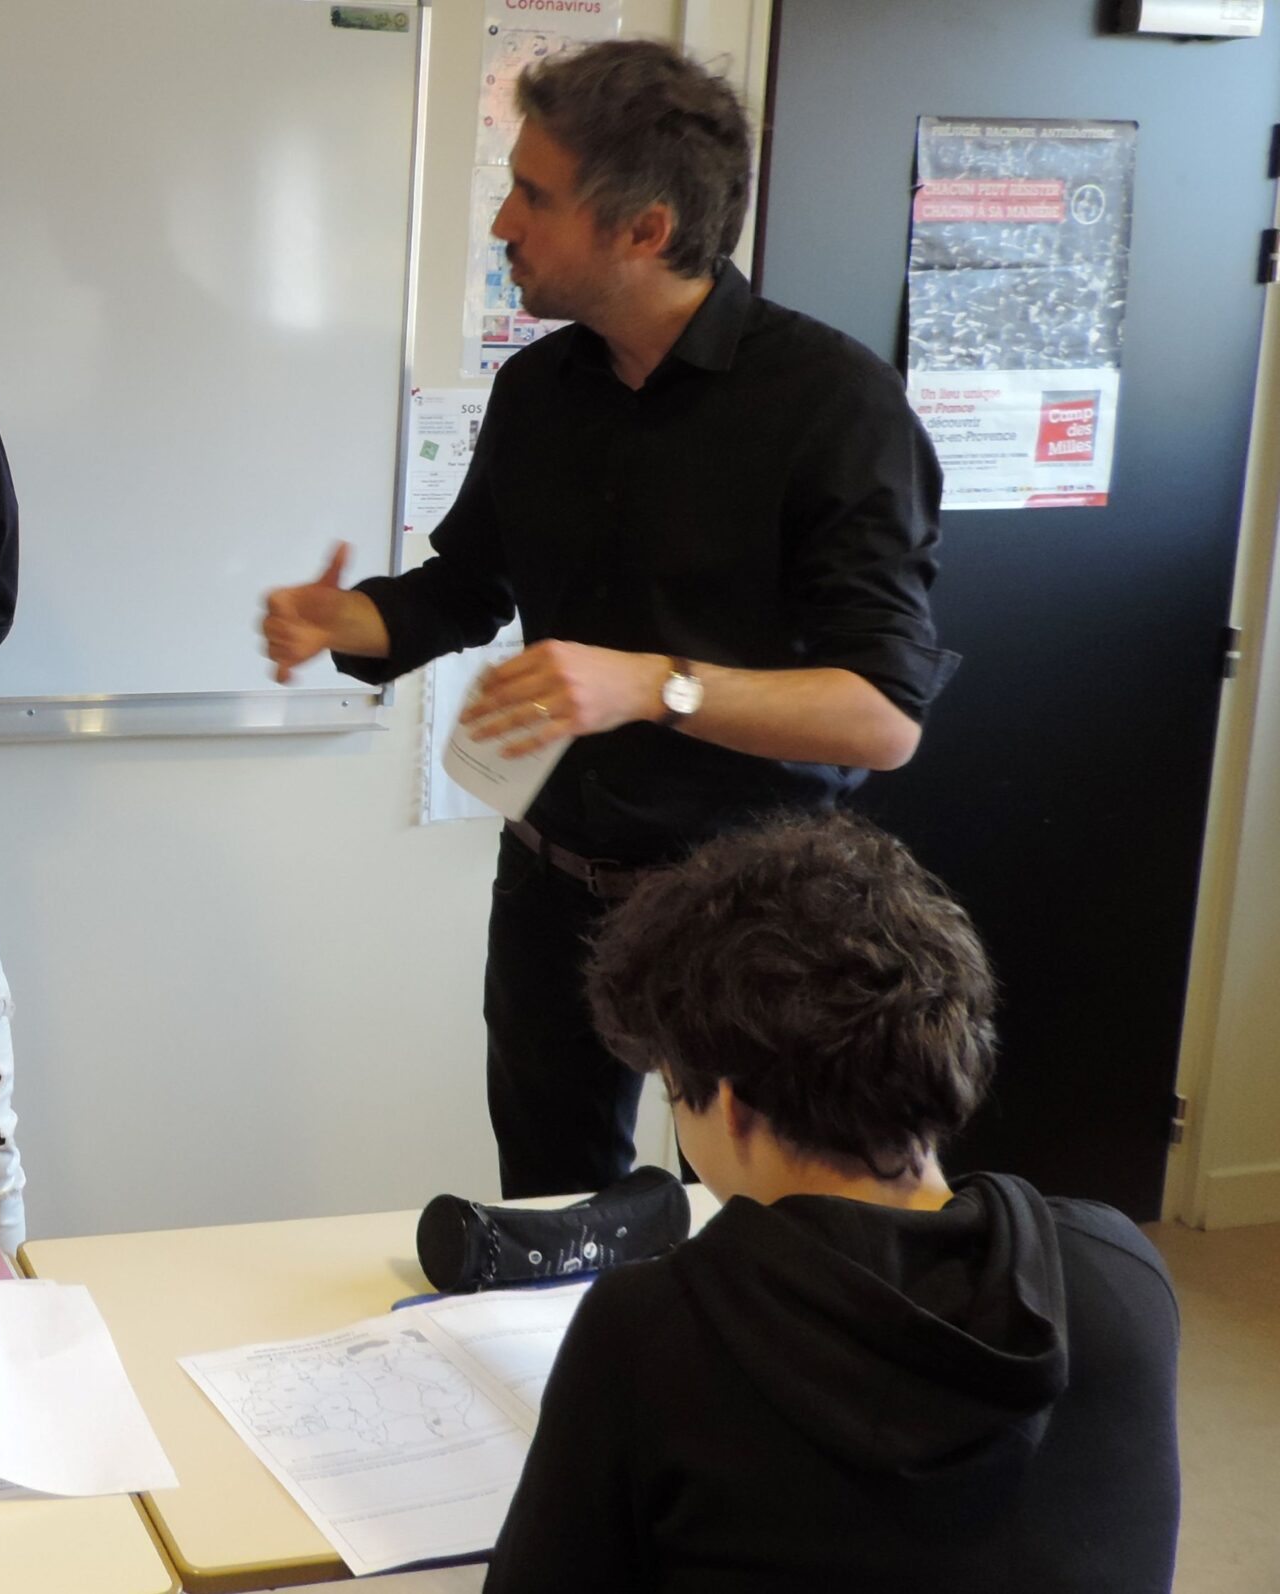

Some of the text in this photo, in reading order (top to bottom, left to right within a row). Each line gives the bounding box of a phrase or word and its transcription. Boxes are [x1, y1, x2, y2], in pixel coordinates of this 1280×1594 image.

[505, 0, 601, 13] Coronavirus
[461, 404, 482, 414] SOS
[1049, 408, 1093, 424] Camp
[1066, 422, 1093, 437] des
[1048, 439, 1093, 456] Milles
